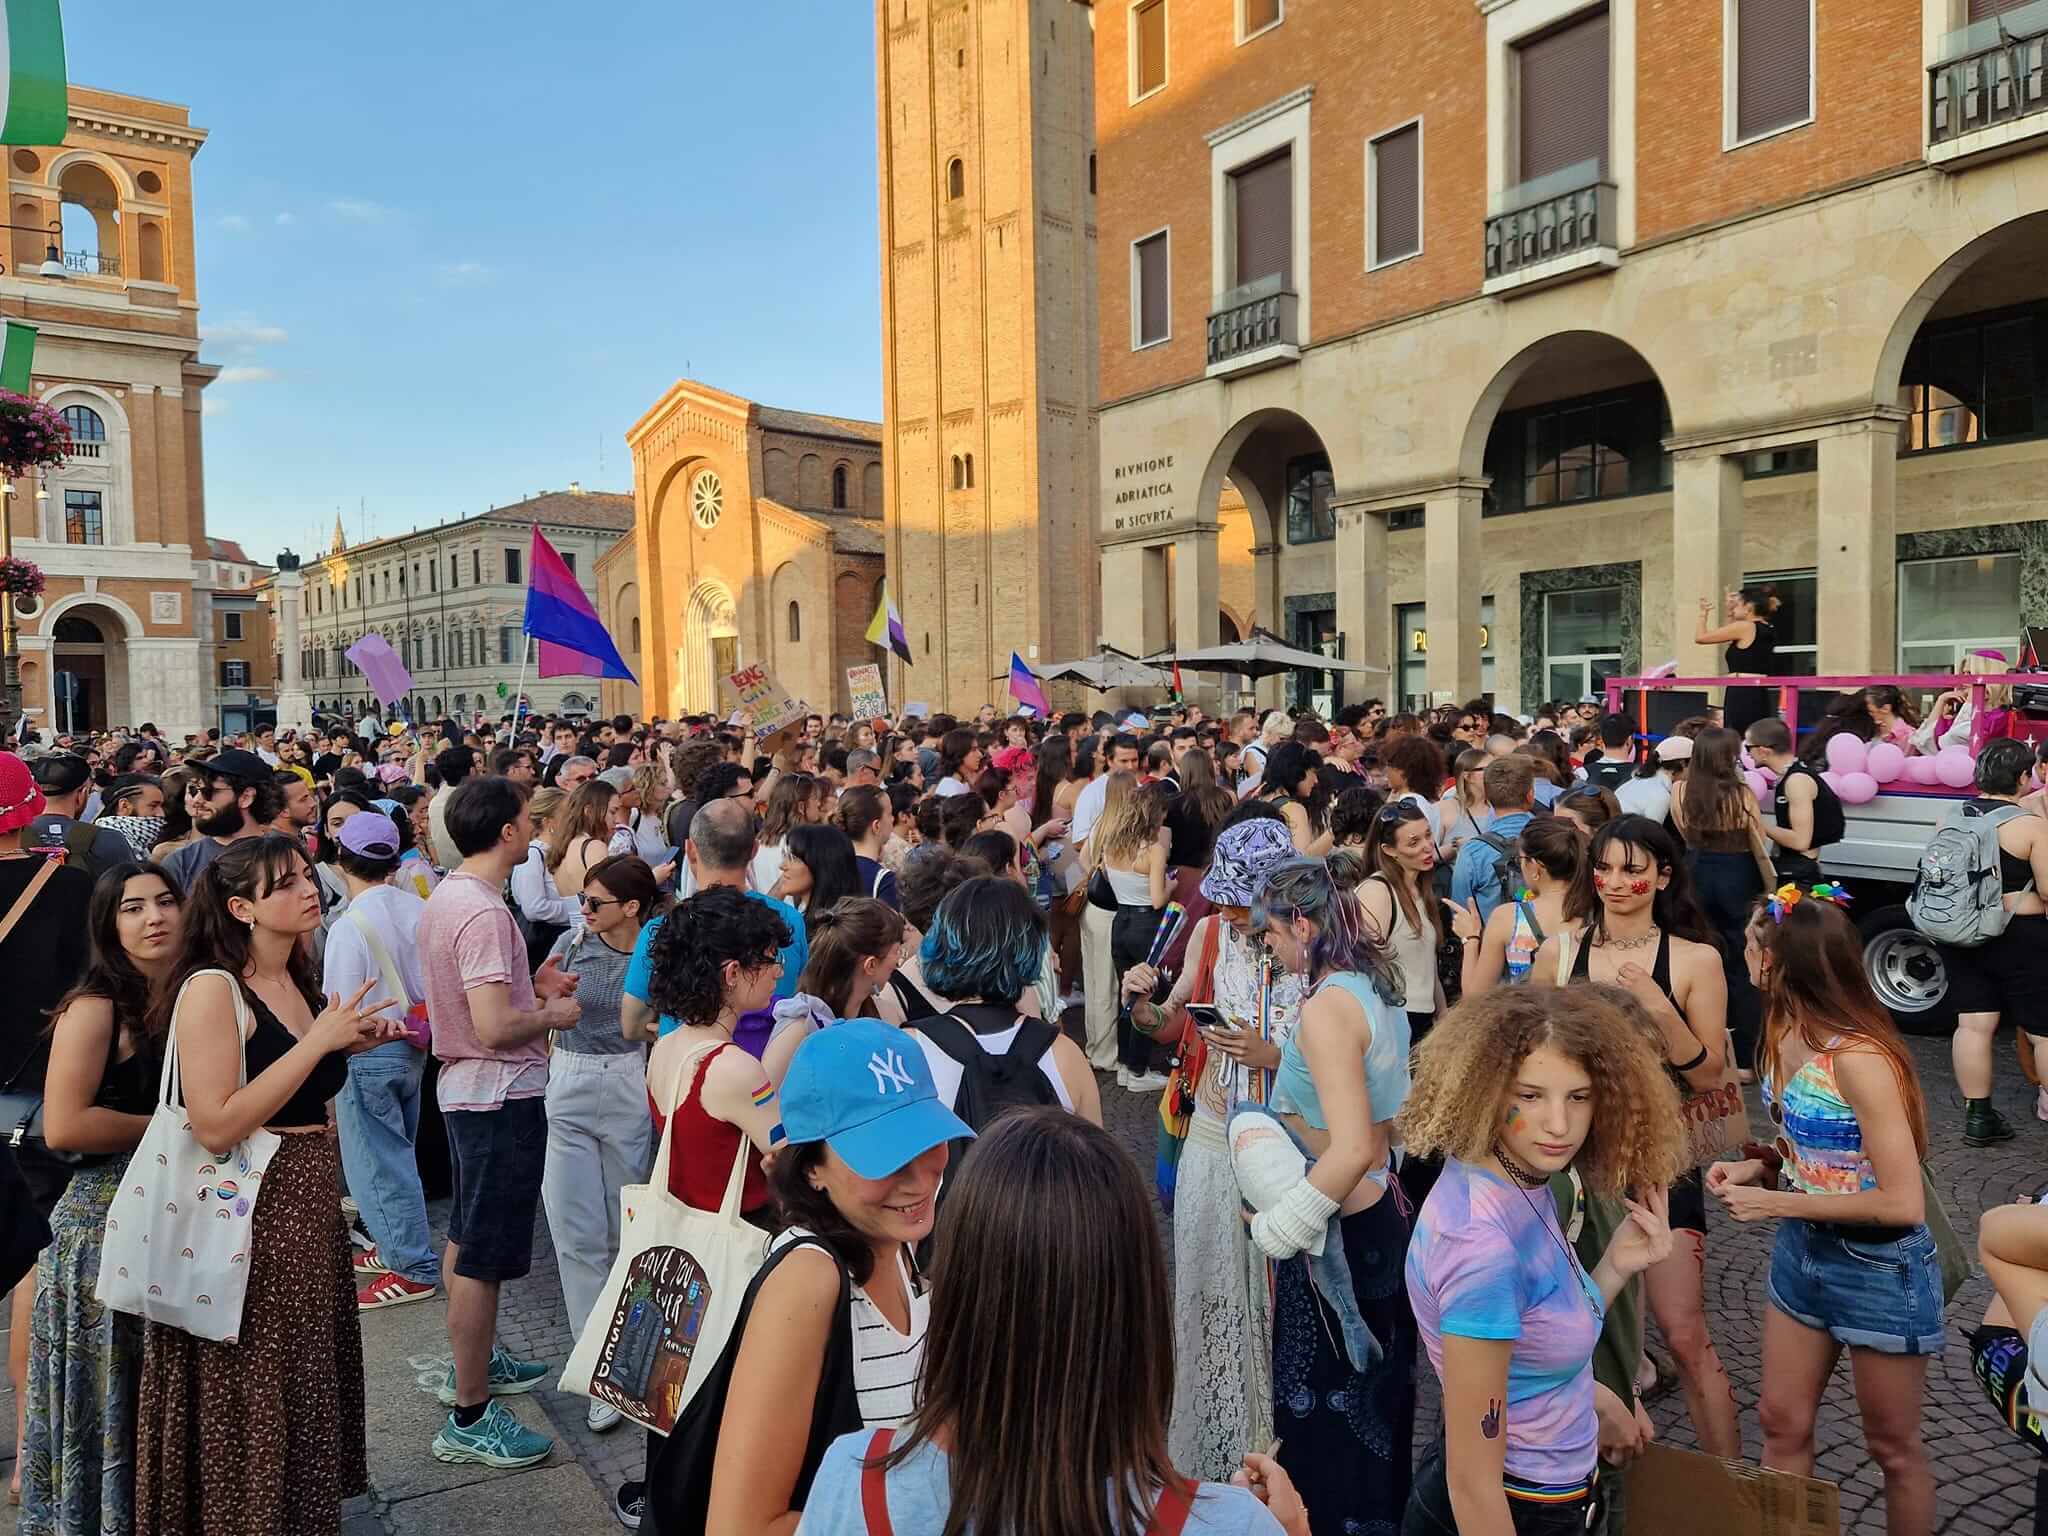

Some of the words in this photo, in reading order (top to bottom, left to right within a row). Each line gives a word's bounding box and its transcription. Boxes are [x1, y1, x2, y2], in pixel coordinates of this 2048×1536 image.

[1114, 455, 1174, 480] RIVNIONE
[1115, 482, 1174, 504] ADRIATICA
[1115, 517, 1125, 530] DI
[867, 1047, 915, 1095] NY
[639, 1248, 676, 1284] HAVE
[671, 1255, 695, 1288] YOU
[597, 1273, 633, 1378] KISSED
[655, 1287, 684, 1326] EVER
